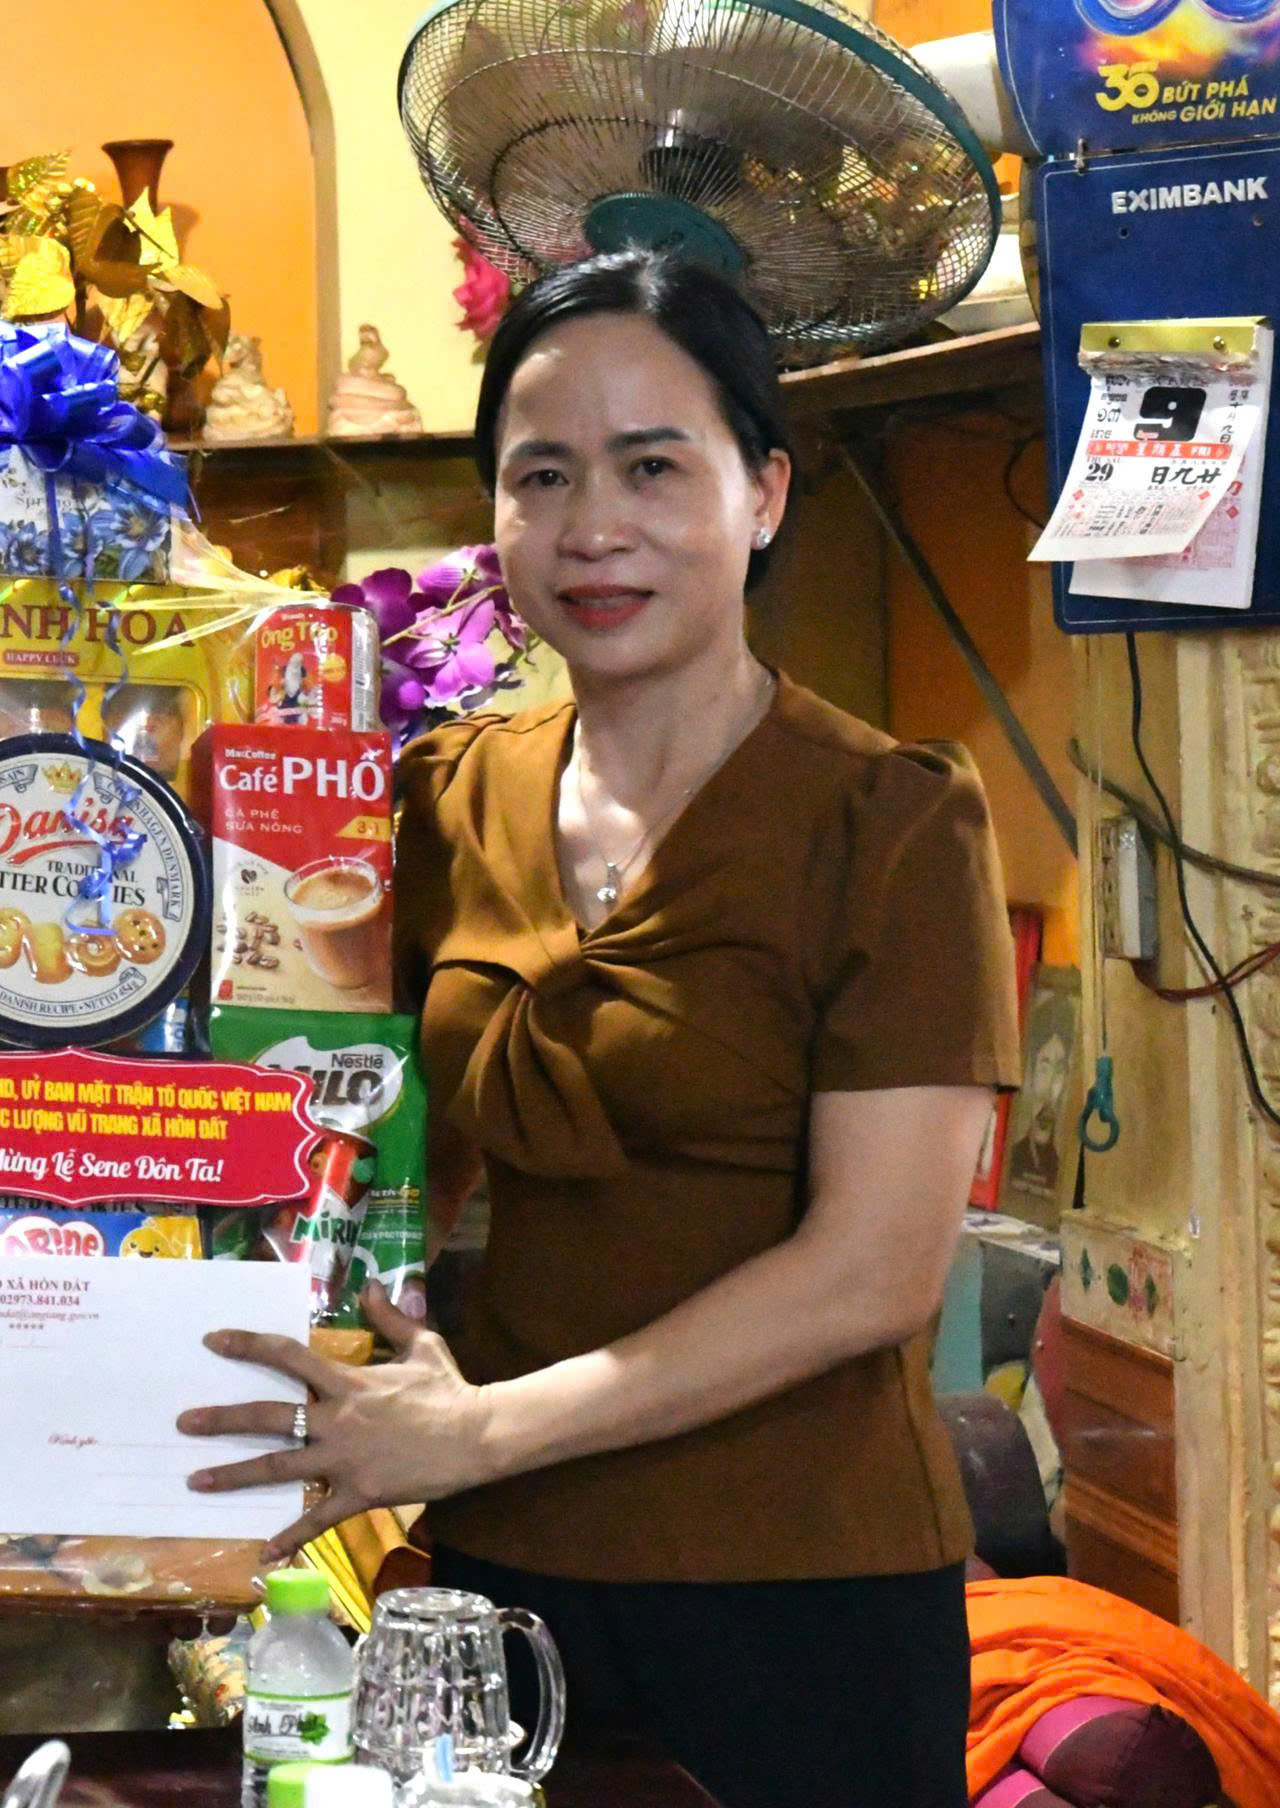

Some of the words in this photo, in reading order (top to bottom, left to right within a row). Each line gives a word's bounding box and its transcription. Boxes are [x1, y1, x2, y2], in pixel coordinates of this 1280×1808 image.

[1162, 80, 1200, 104] BỨT
[1205, 74, 1250, 99] PHÁ
[1131, 109, 1177, 125] KHÔNG
[1179, 99, 1225, 123] GIỚI
[1231, 97, 1277, 120] HẠN
[1111, 176, 1268, 214] EXIMBANK
[1084, 463, 1114, 482] 29
[219, 763, 279, 793] Café
[281, 749, 386, 802] PHỐ
[52, 875, 147, 907] COIES
[44, 1080, 75, 1102] BAN
[77, 1079, 113, 1108] MẶT
[114, 1080, 154, 1110] TRẬN
[177, 1084, 219, 1110] QUỐC
[220, 1087, 252, 1115] VIỆT
[254, 1091, 292, 1112] NAM
[266, 1064, 385, 1106] ILO
[13, 1107, 64, 1135] LƯỢNG
[66, 1108, 88, 1133] VŨ
[89, 1113, 139, 1135] TRANG
[141, 1111, 162, 1136] XÃ
[164, 1113, 196, 1139] HÒN
[198, 1115, 228, 1140] ĐẤT
[51, 1148, 77, 1182] Lễ
[79, 1152, 131, 1178] Sene
[135, 1155, 184, 1181] Đôn
[185, 1157, 225, 1183] Ta!
[6, 1276, 25, 1291] XÃ
[29, 1277, 59, 1291] HÒN
[63, 1277, 91, 1292] ĐẤT
